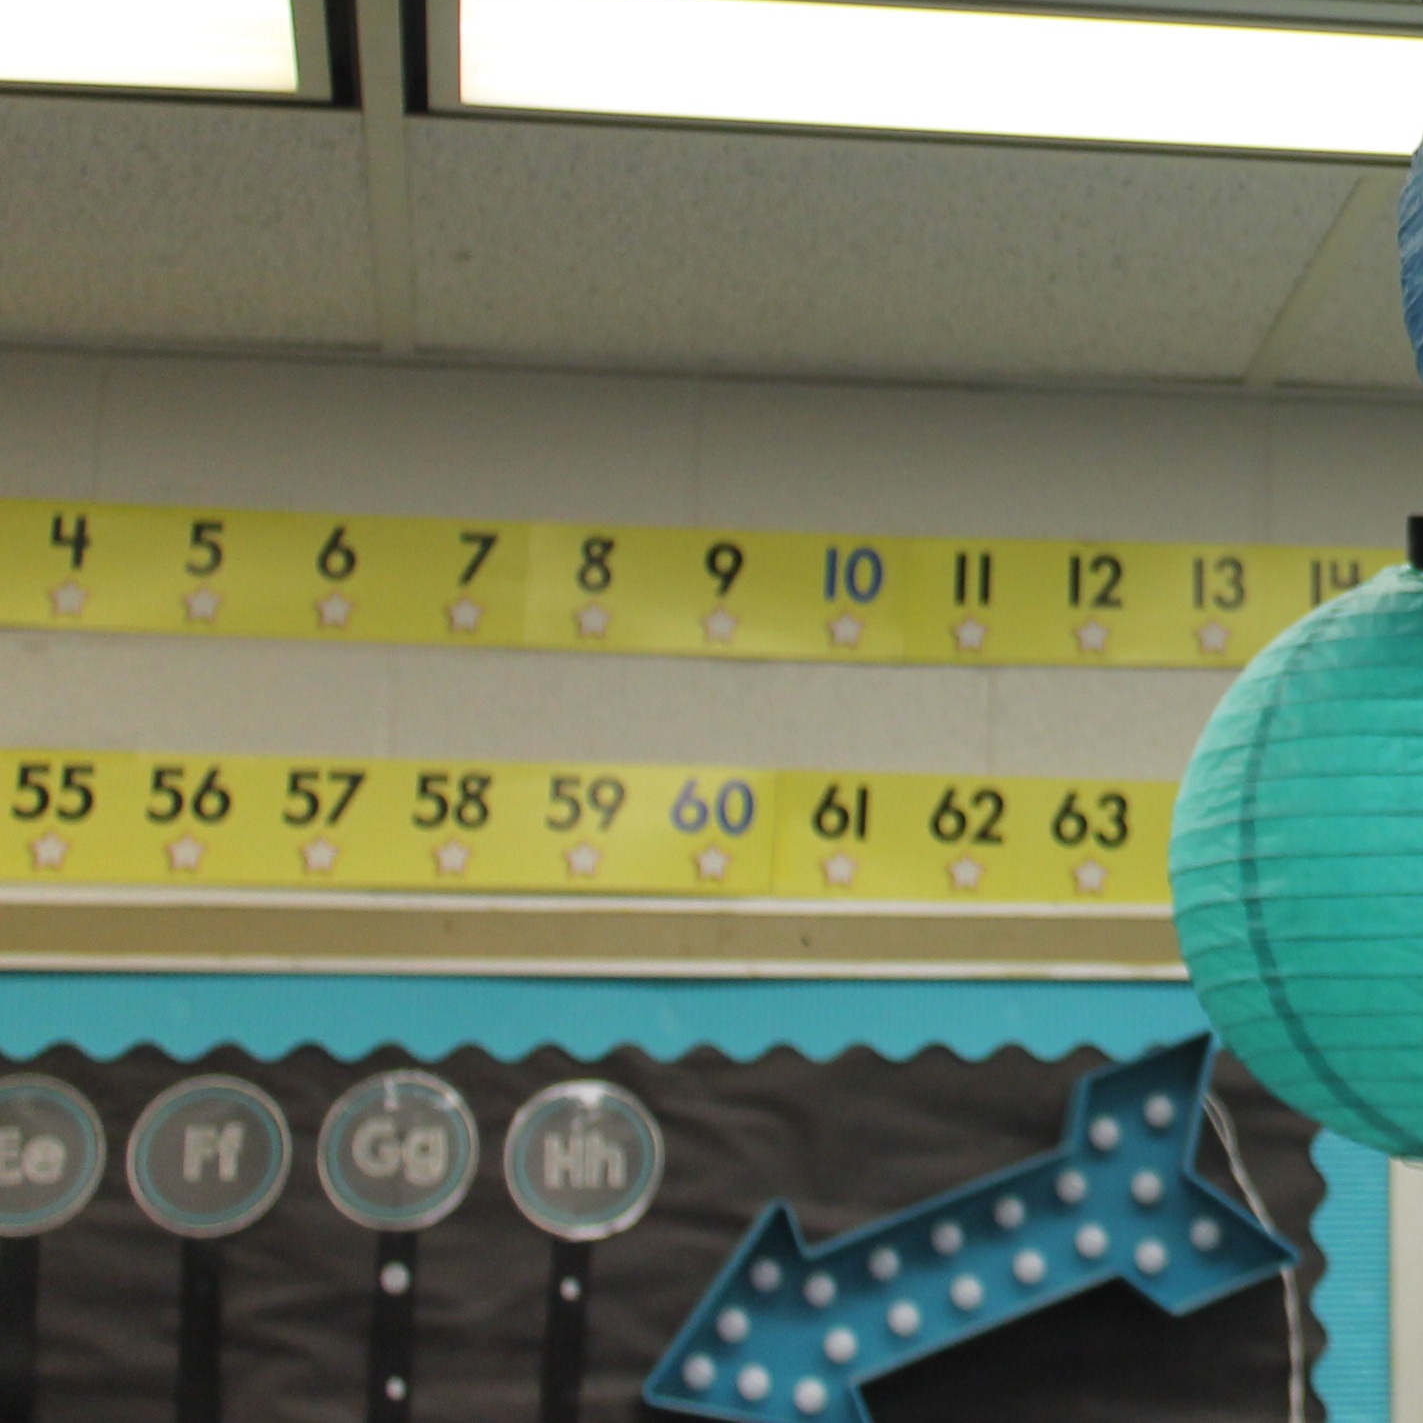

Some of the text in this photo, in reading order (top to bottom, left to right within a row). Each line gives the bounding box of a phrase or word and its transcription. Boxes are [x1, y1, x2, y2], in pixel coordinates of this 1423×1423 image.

[49, 515, 90, 569] 4
[185, 522, 225, 577] 5
[316, 526, 357, 580] 6
[458, 532, 497, 586] 7
[577, 536, 615, 591] 8
[705, 542, 744, 597] 9
[823, 546, 884, 604] 10
[953, 552, 992, 605] 11
[1067, 554, 1124, 610] 12
[1192, 556, 1244, 611] 13
[11, 763, 1129, 847] 55 56 57 58 59 60 61 62 63
[183, 1121, 243, 1182] Ff
[351, 1117, 449, 1186] Gg
